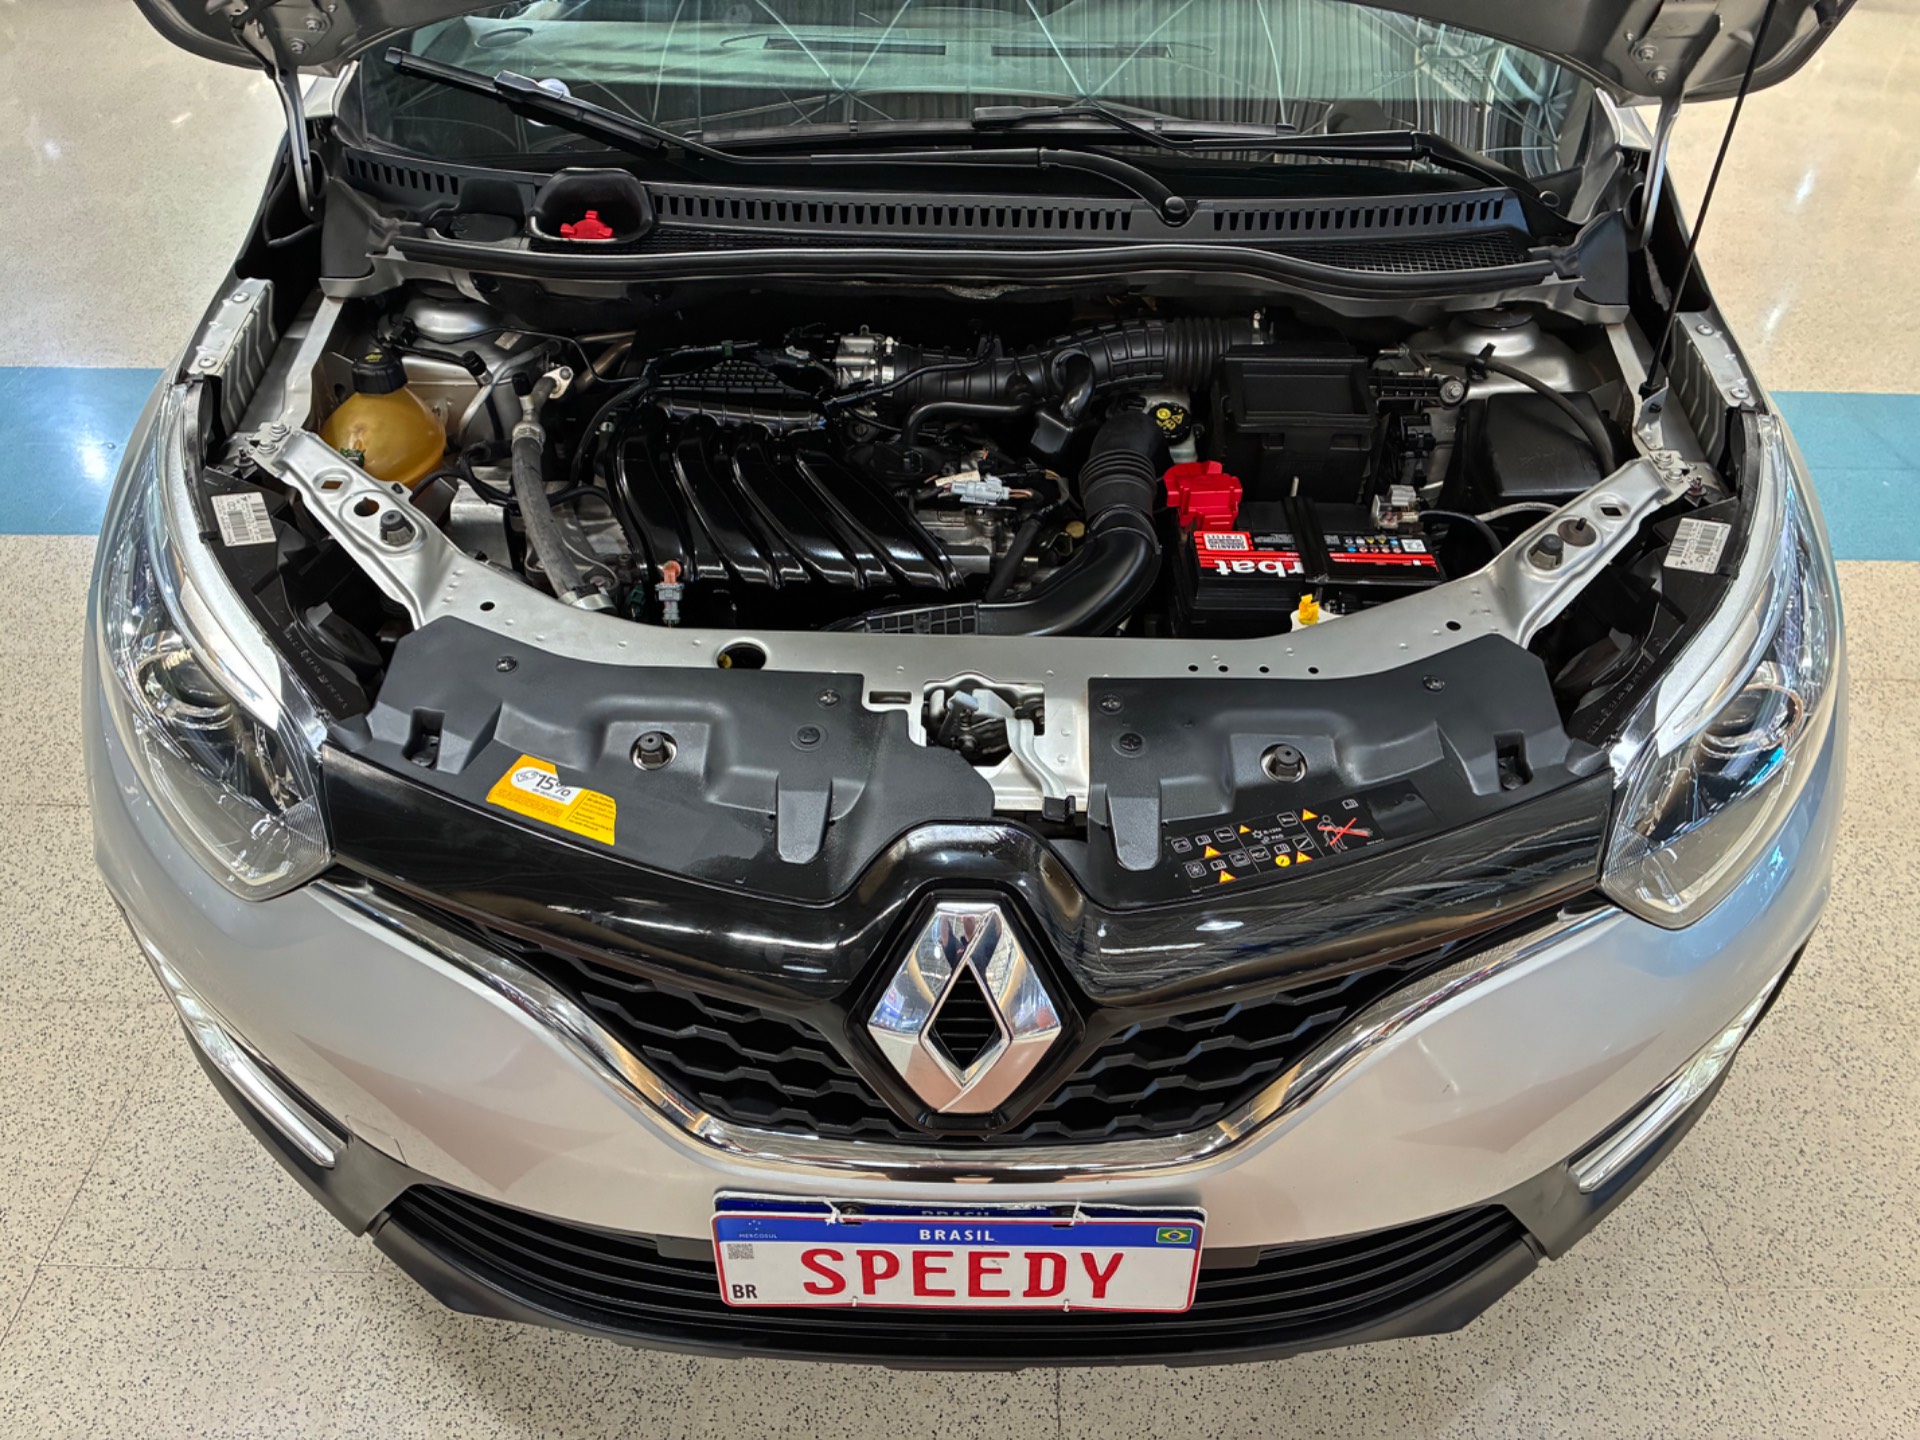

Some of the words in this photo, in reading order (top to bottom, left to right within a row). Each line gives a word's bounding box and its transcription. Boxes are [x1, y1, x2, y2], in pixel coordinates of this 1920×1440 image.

[1214, 560, 1305, 578] rbat
[535, 773, 571, 797] 15%
[919, 1229, 995, 1242] BRASIL
[800, 1248, 1124, 1299] SPEEDY
[732, 1284, 758, 1299] BR
